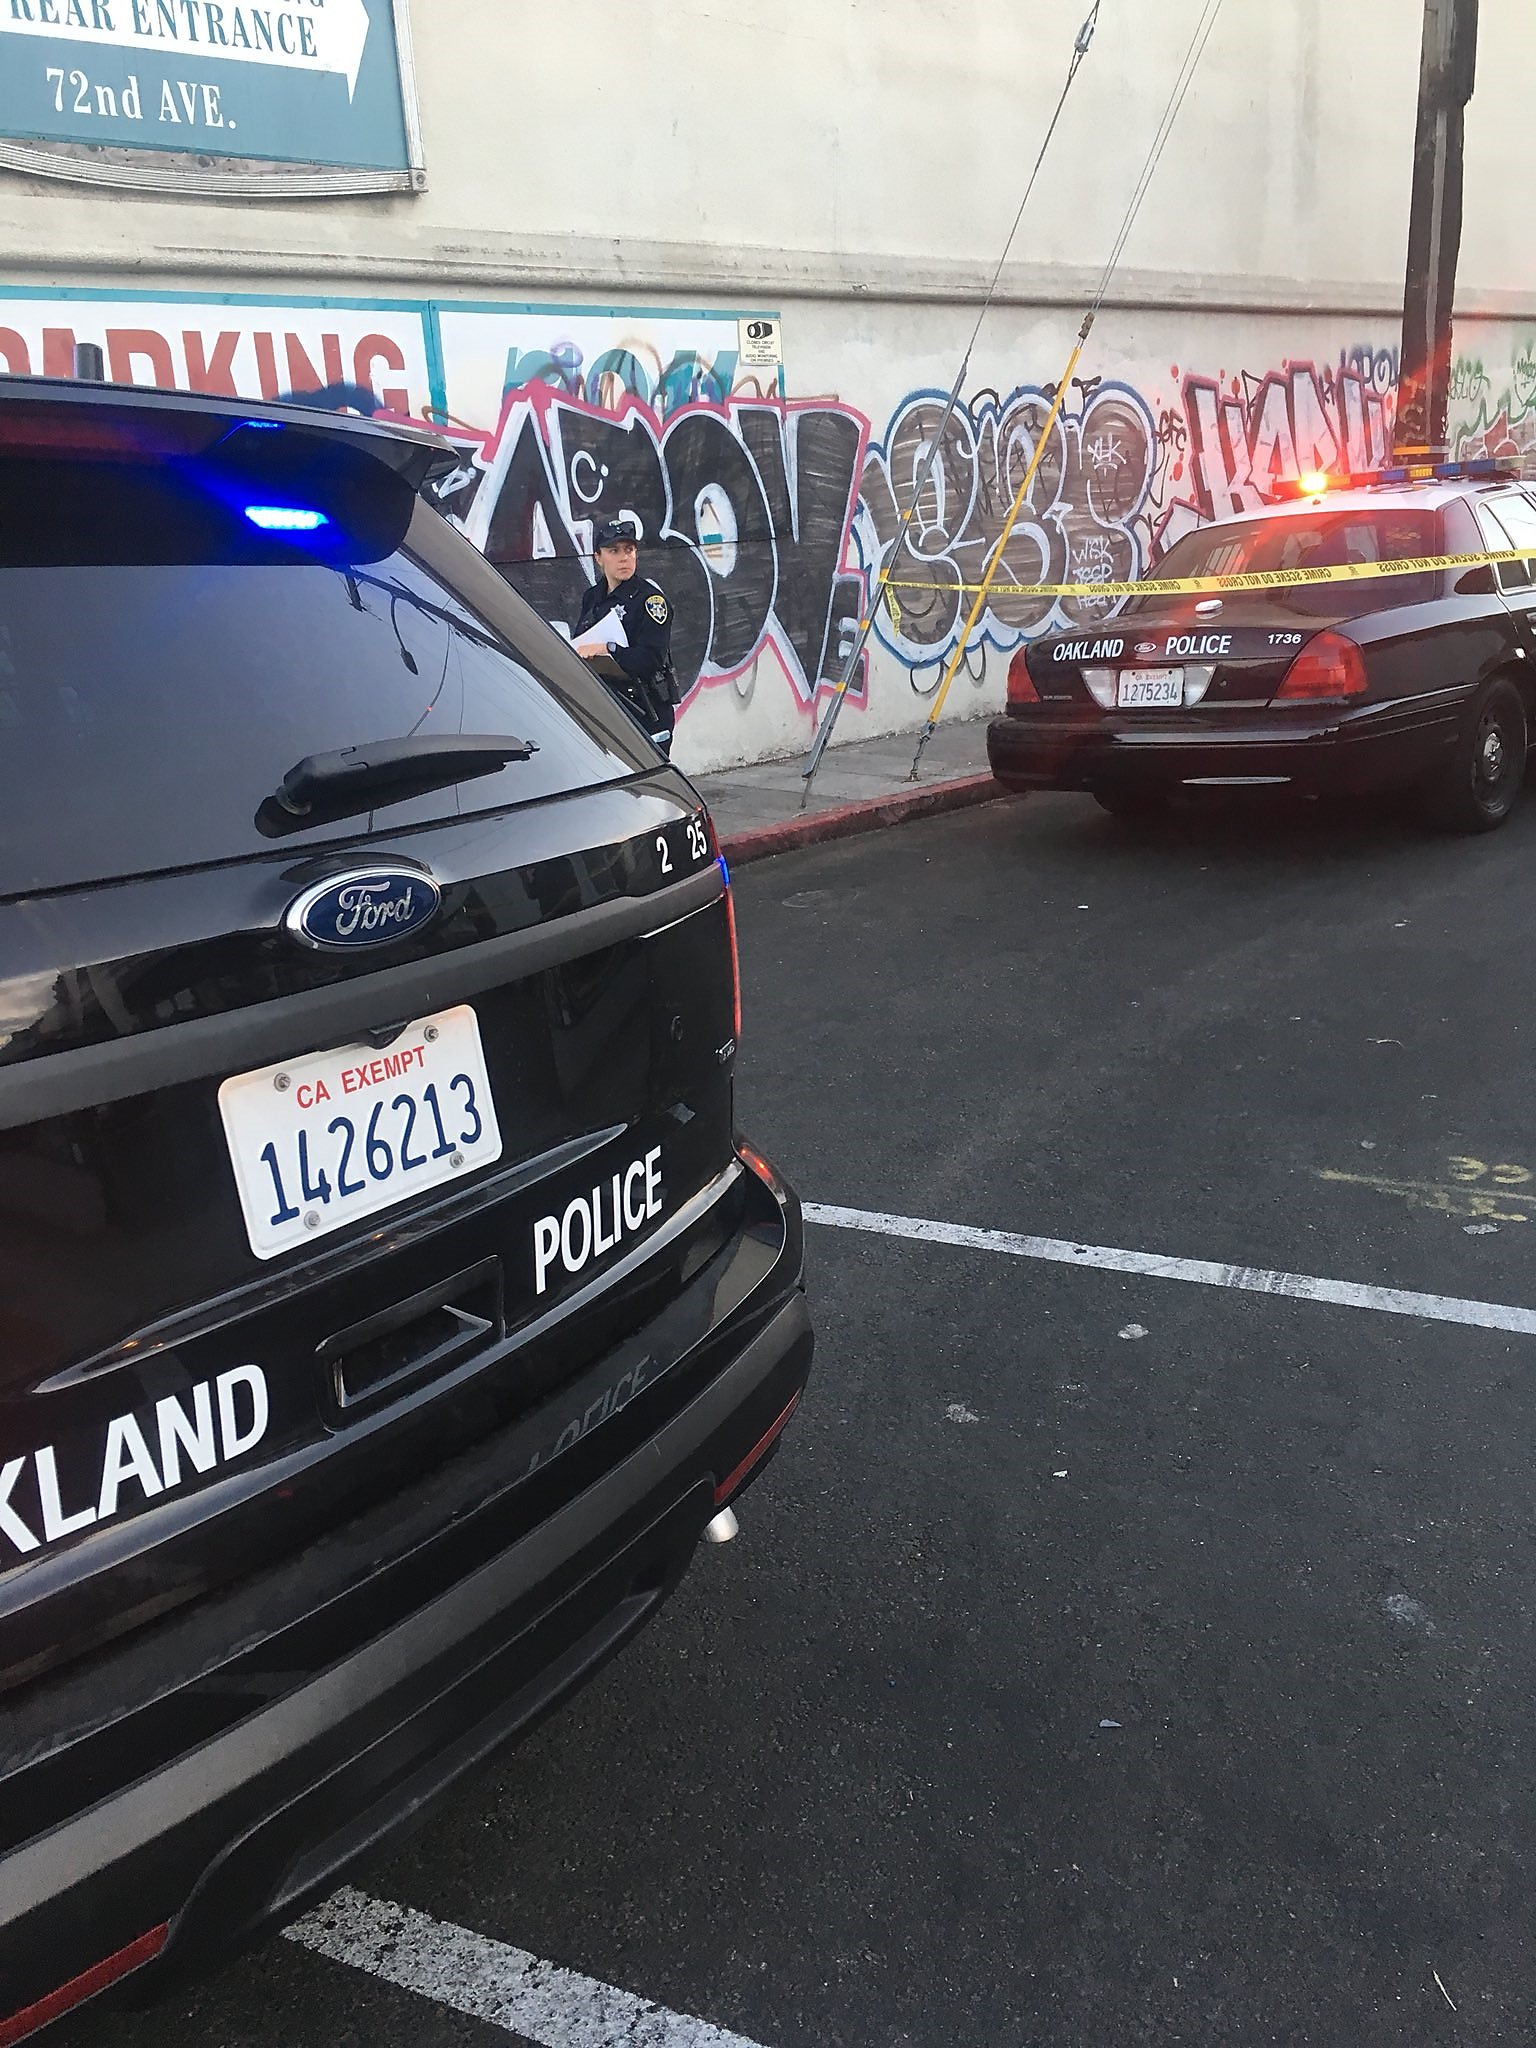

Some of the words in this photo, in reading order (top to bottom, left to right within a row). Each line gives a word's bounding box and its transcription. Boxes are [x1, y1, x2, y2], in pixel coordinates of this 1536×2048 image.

[131, 0, 318, 57] ENTRANCE
[46, 67, 144, 120] 72nd
[158, 79, 237, 130] AVE.
[1052, 638, 1125, 662] OAKLAND
[1165, 635, 1233, 656] POLICE
[1267, 633, 1303, 645] 1736
[1122, 682, 1178, 702] 1275234
[656, 836, 674, 874] 2
[686, 820, 708, 861] 25
[335, 880, 416, 936] Ford
[296, 1079, 332, 1110] CA
[341, 1045, 426, 1094] EXEMPT
[260, 1073, 483, 1226] 1426213
[533, 1144, 663, 1295] POLICE
[0, 1364, 269, 1554] KLAND
